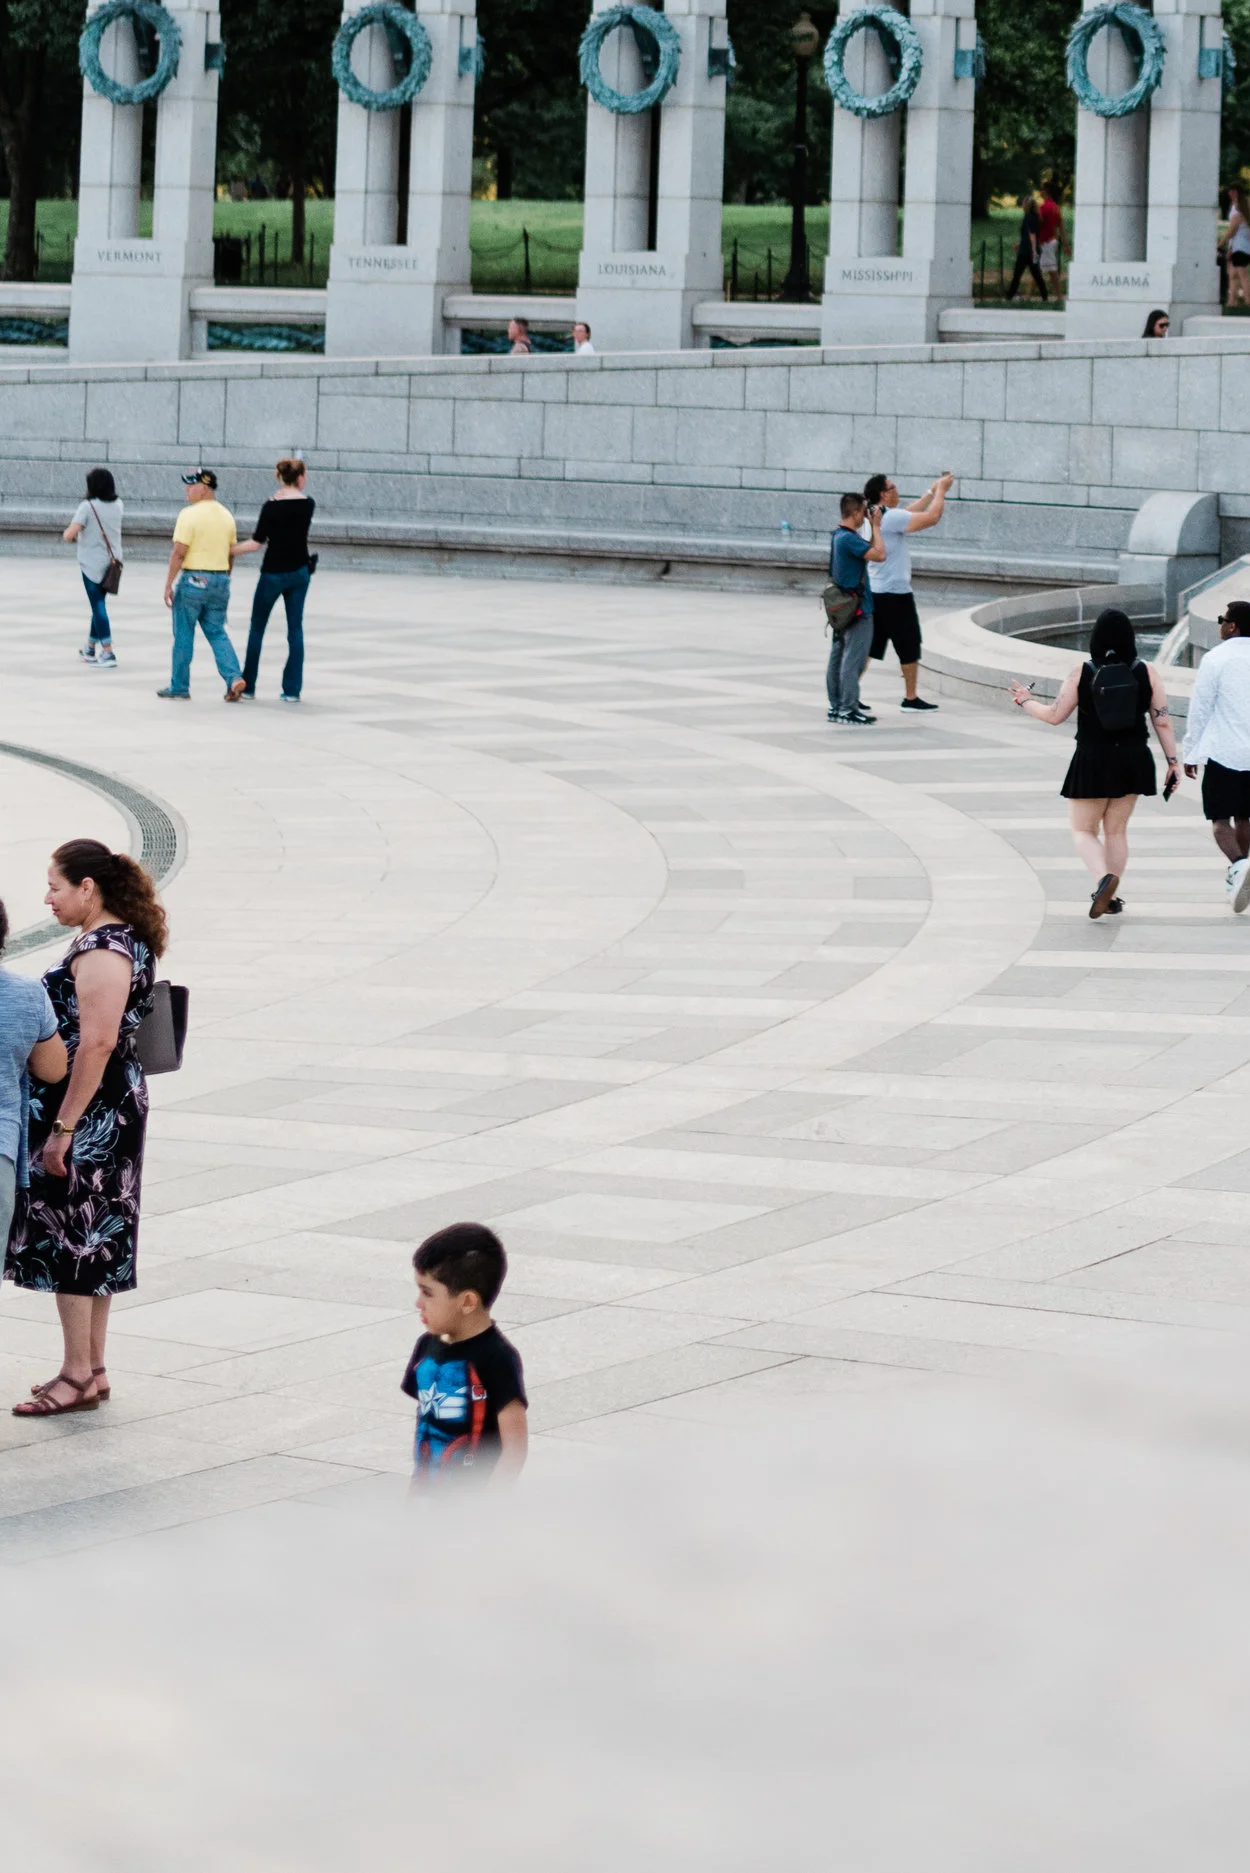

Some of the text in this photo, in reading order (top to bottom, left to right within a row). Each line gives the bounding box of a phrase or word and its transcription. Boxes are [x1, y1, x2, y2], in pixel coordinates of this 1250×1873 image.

[97, 251, 163, 264] VERMONT
[348, 256, 417, 270] TENNESSEE
[598, 263, 666, 277] LOUISIANA
[841, 269, 914, 282] MISSISSIPPI
[1091, 275, 1150, 288] ALABAMA
